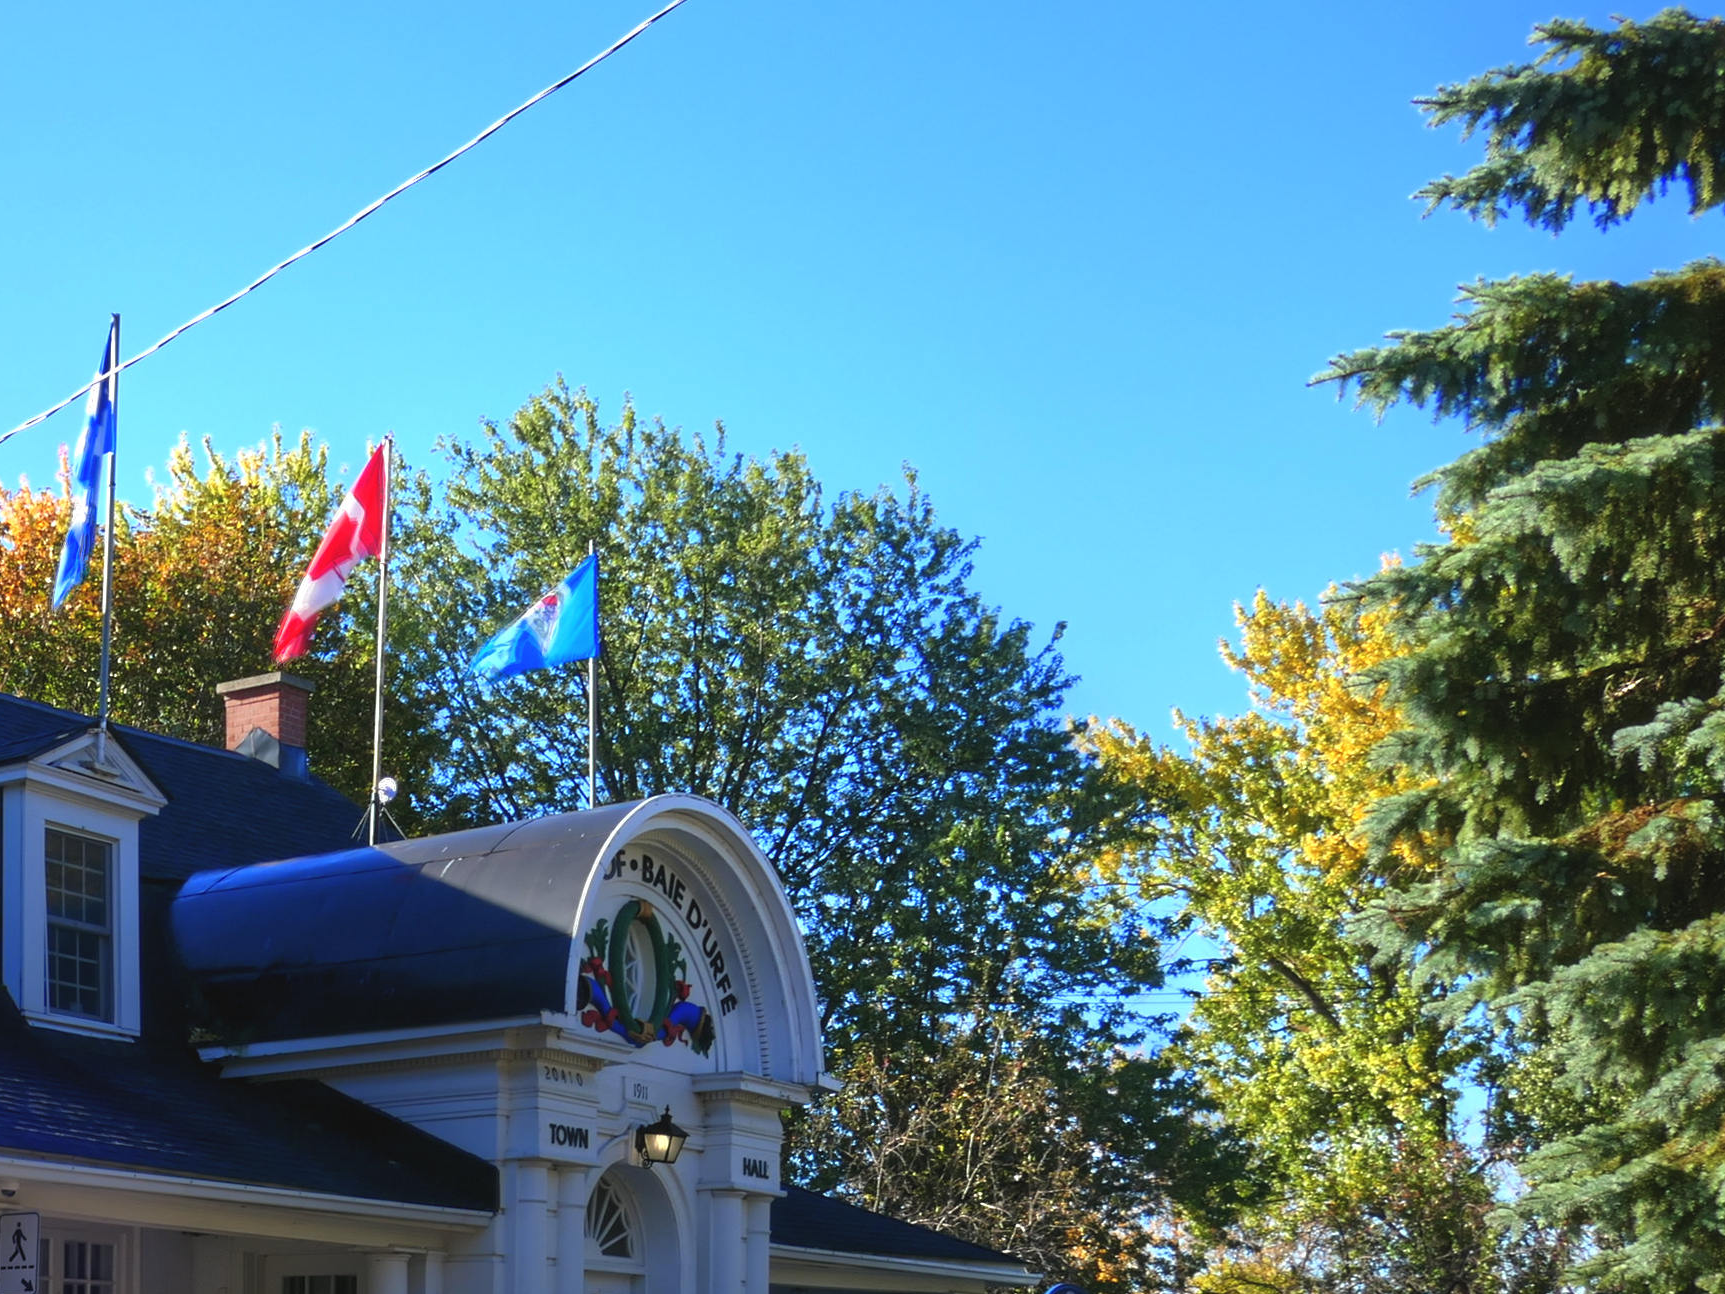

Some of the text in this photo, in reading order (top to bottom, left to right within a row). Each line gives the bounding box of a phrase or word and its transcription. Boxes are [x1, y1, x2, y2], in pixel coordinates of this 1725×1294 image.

[642, 854, 686, 911] BAIE
[544, 1066, 584, 1087] 20410
[633, 1083, 649, 1101] 1911
[549, 1123, 589, 1150] TOWN
[743, 1157, 770, 1180] HALL
